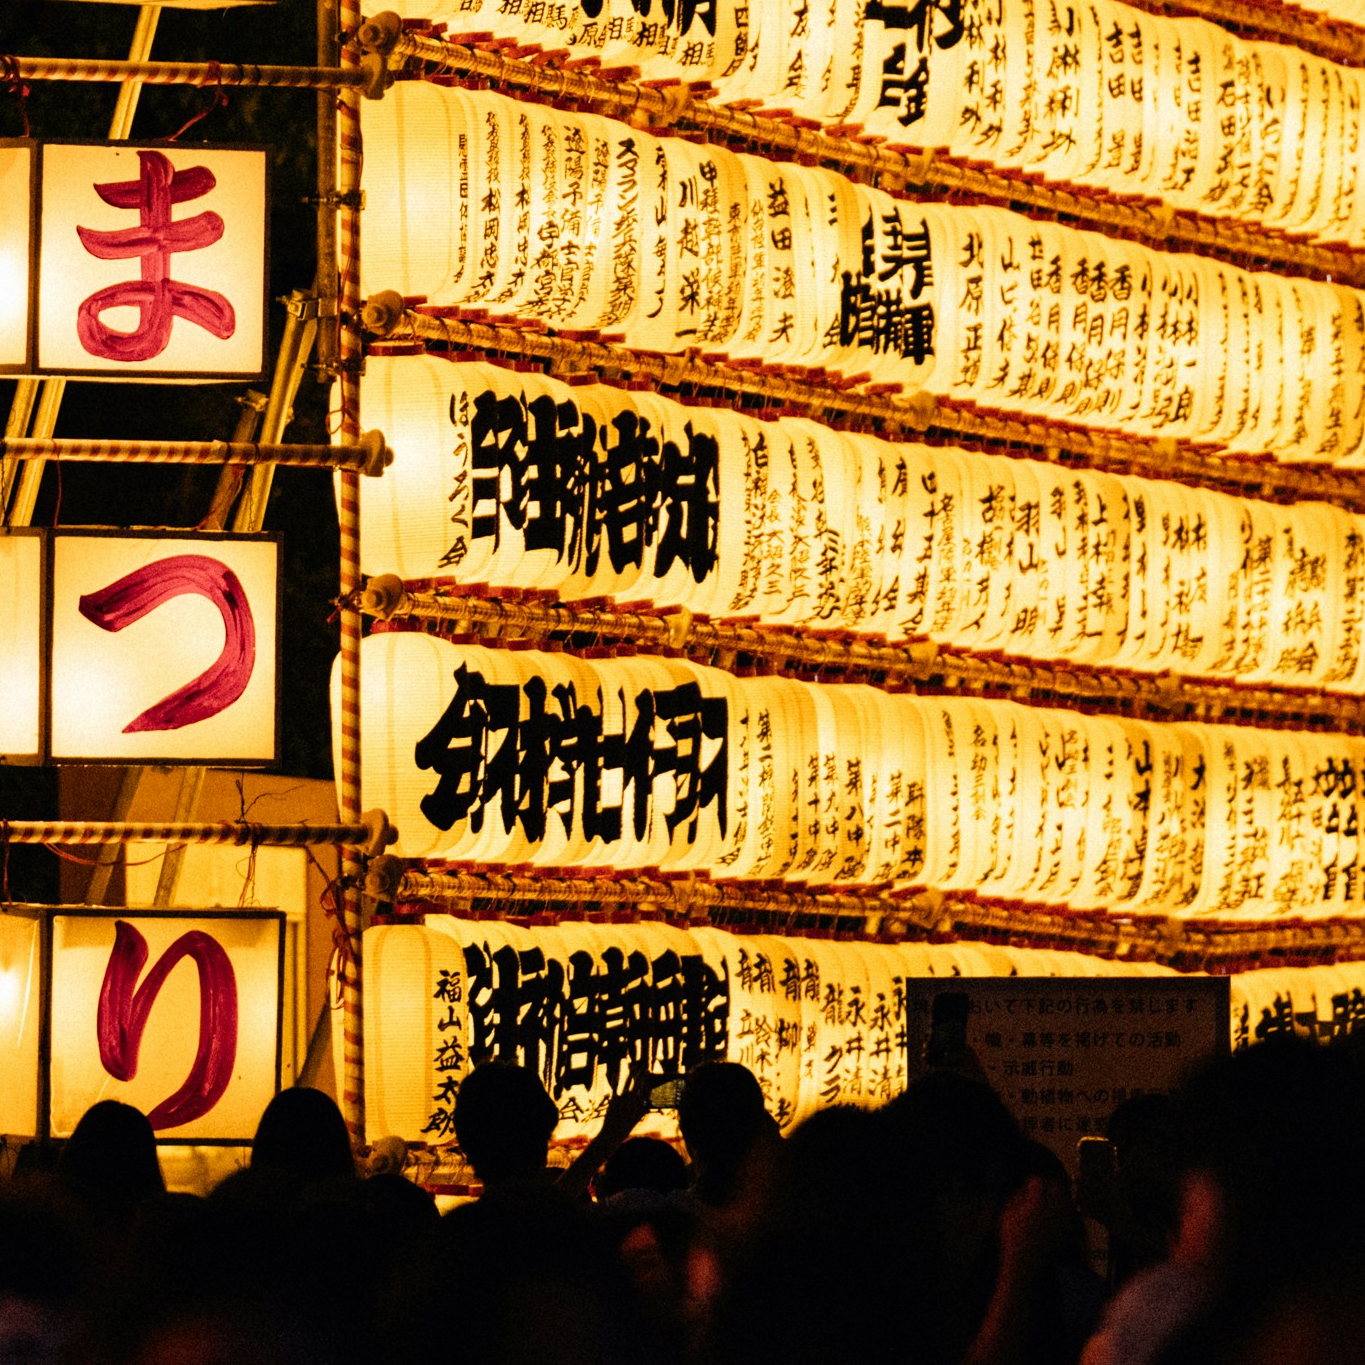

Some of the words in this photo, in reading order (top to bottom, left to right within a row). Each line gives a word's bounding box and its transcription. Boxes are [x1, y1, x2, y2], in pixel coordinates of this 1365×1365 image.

[76, 150, 236, 362] ま
[78, 554, 255, 734] つ
[97, 920, 238, 1131] り
